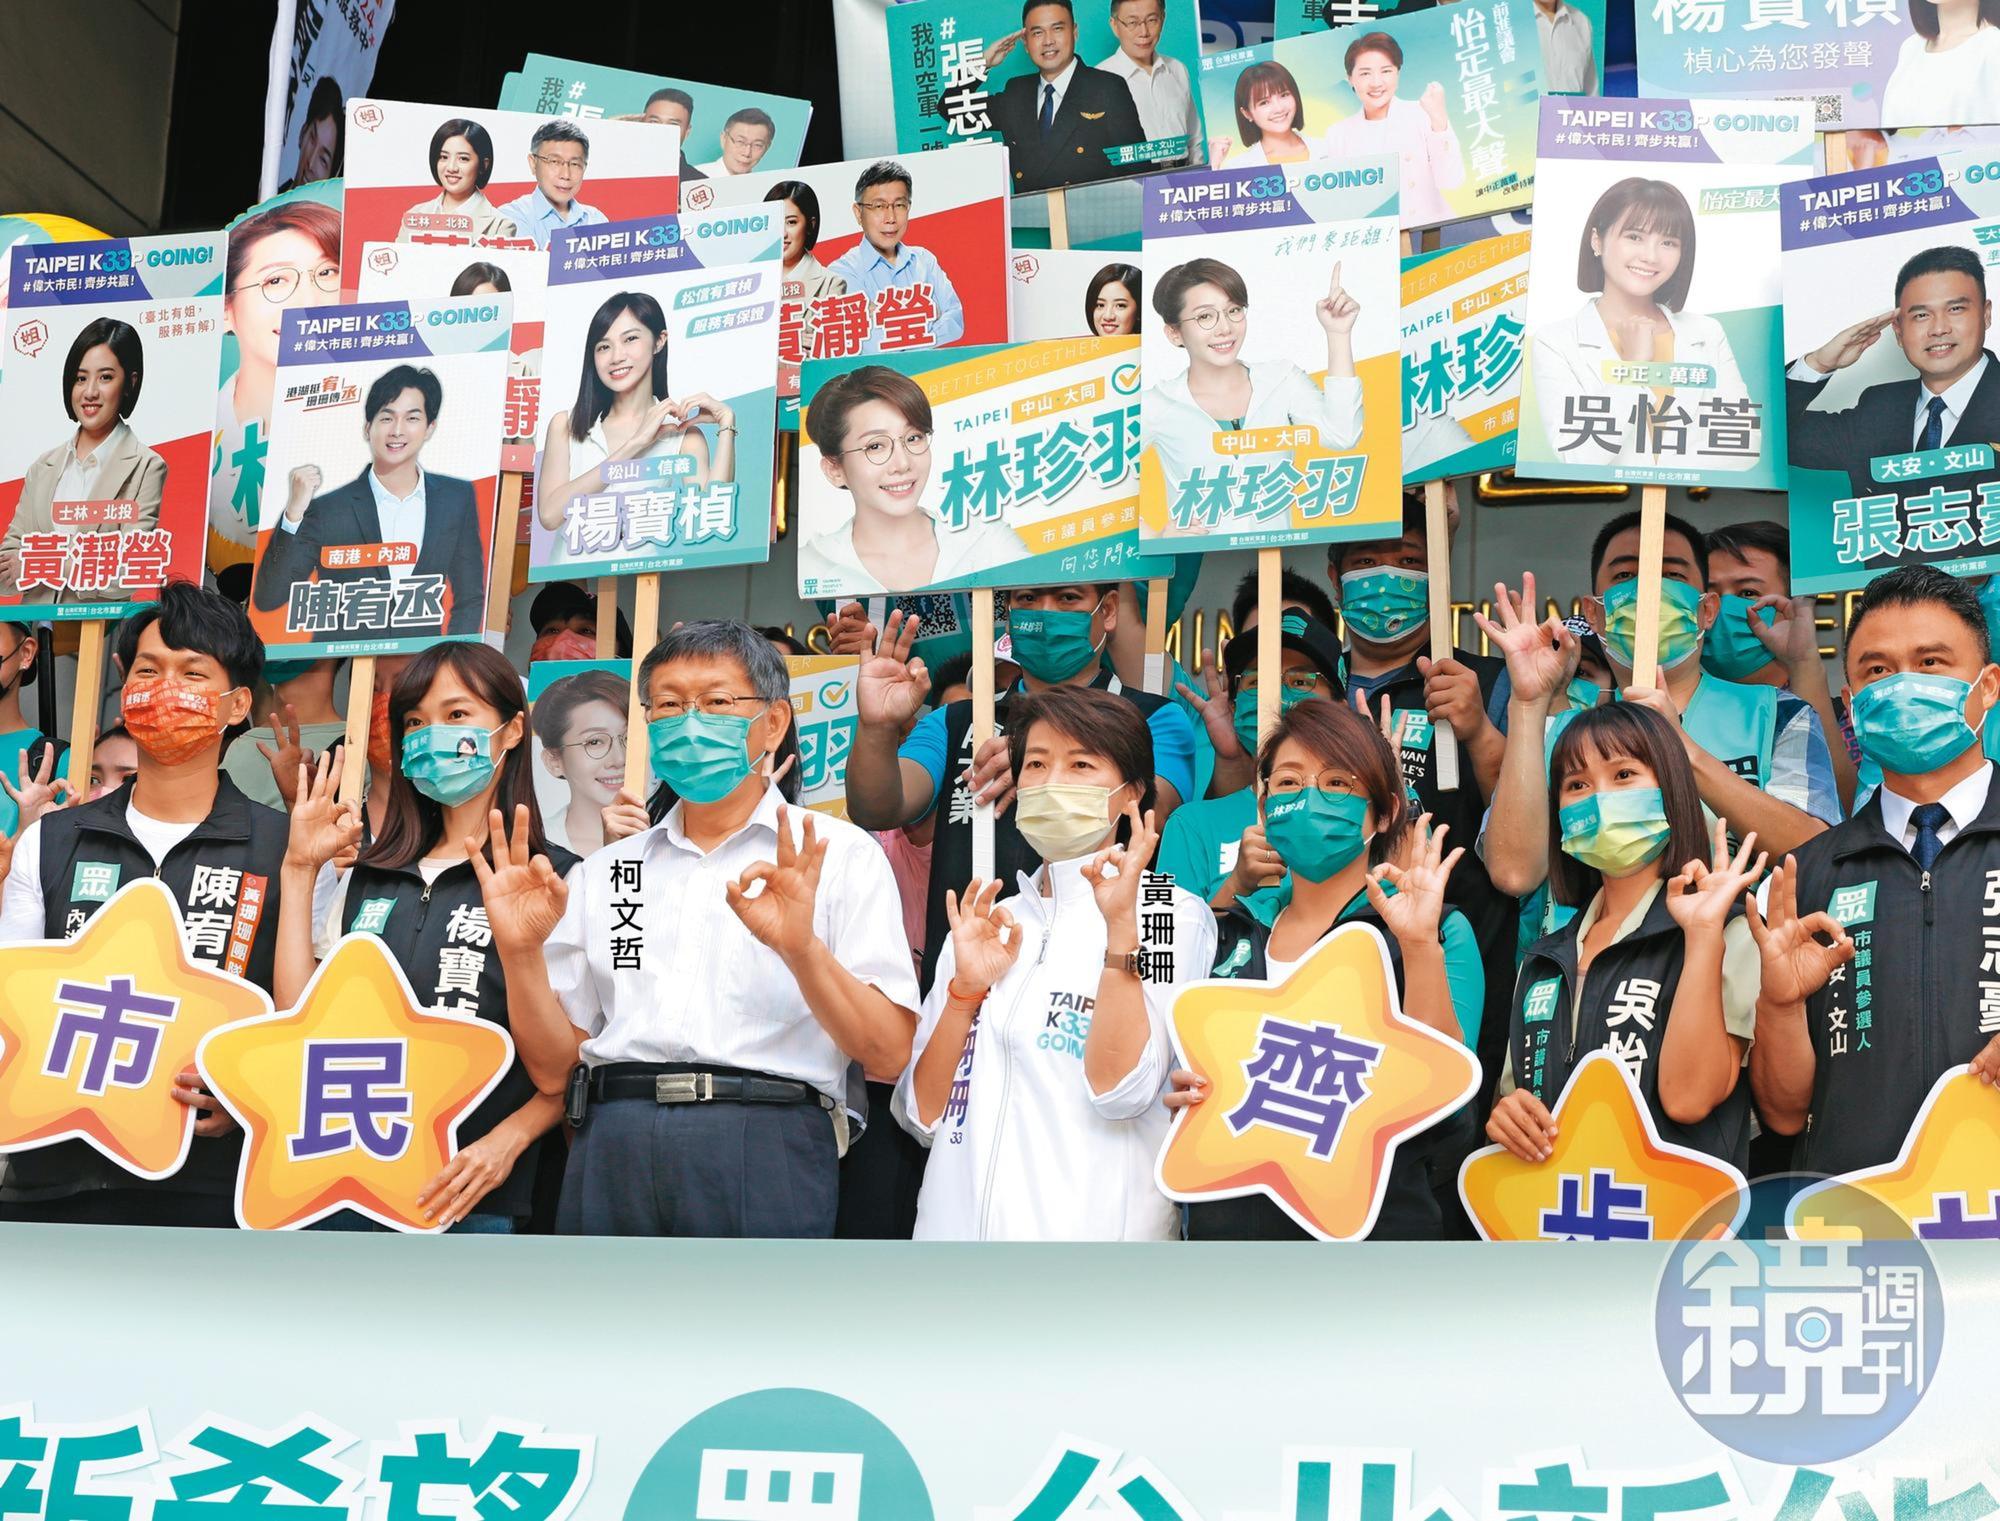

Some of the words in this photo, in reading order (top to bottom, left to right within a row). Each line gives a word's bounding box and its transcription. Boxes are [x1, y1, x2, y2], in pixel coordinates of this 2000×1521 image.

[1684, 41, 1873, 75] 楨心為您發聲
[536, 77, 565, 115] 我的
[939, 17, 1000, 148] #張志
[1452, 12, 1511, 182] 怡定最大聲
[1556, 109, 1634, 132] TAIPEI
[1713, 114, 1799, 132] GOING!
[1159, 183, 1230, 205] TAIPEI
[1304, 170, 1383, 191] GOING!
[1799, 182, 1882, 212] TAIPEI
[565, 231, 630, 255] TAIPEI
[697, 214, 770, 239] GOING!
[25, 253, 84, 275] TAIPEI
[146, 246, 214, 269] GOING!
[20, 326, 42, 347] 姐
[297, 314, 361, 336] TAIPEI
[427, 305, 500, 326] GOING!
[954, 407, 1010, 433] TAIPEI
[1557, 393, 1764, 458] 吳怡萱
[1220, 430, 1312, 453] 中山・大同
[939, 402, 1142, 530] 林珍羽
[1881, 451, 1986, 479] 大安・文山
[1170, 454, 1368, 531] 林珍羽
[58, 503, 133, 523] 士林・北投
[564, 481, 738, 553] 楊寶楨
[18, 530, 172, 592] 黃瀞瑩
[285, 574, 447, 632] 陳宥丞
[78, 867, 113, 902] 眾
[184, 864, 241, 974] 陳宥
[42, 975, 181, 1096] 市
[287, 1037, 415, 1163] 民
[1220, 1012, 1389, 1163] 齊
